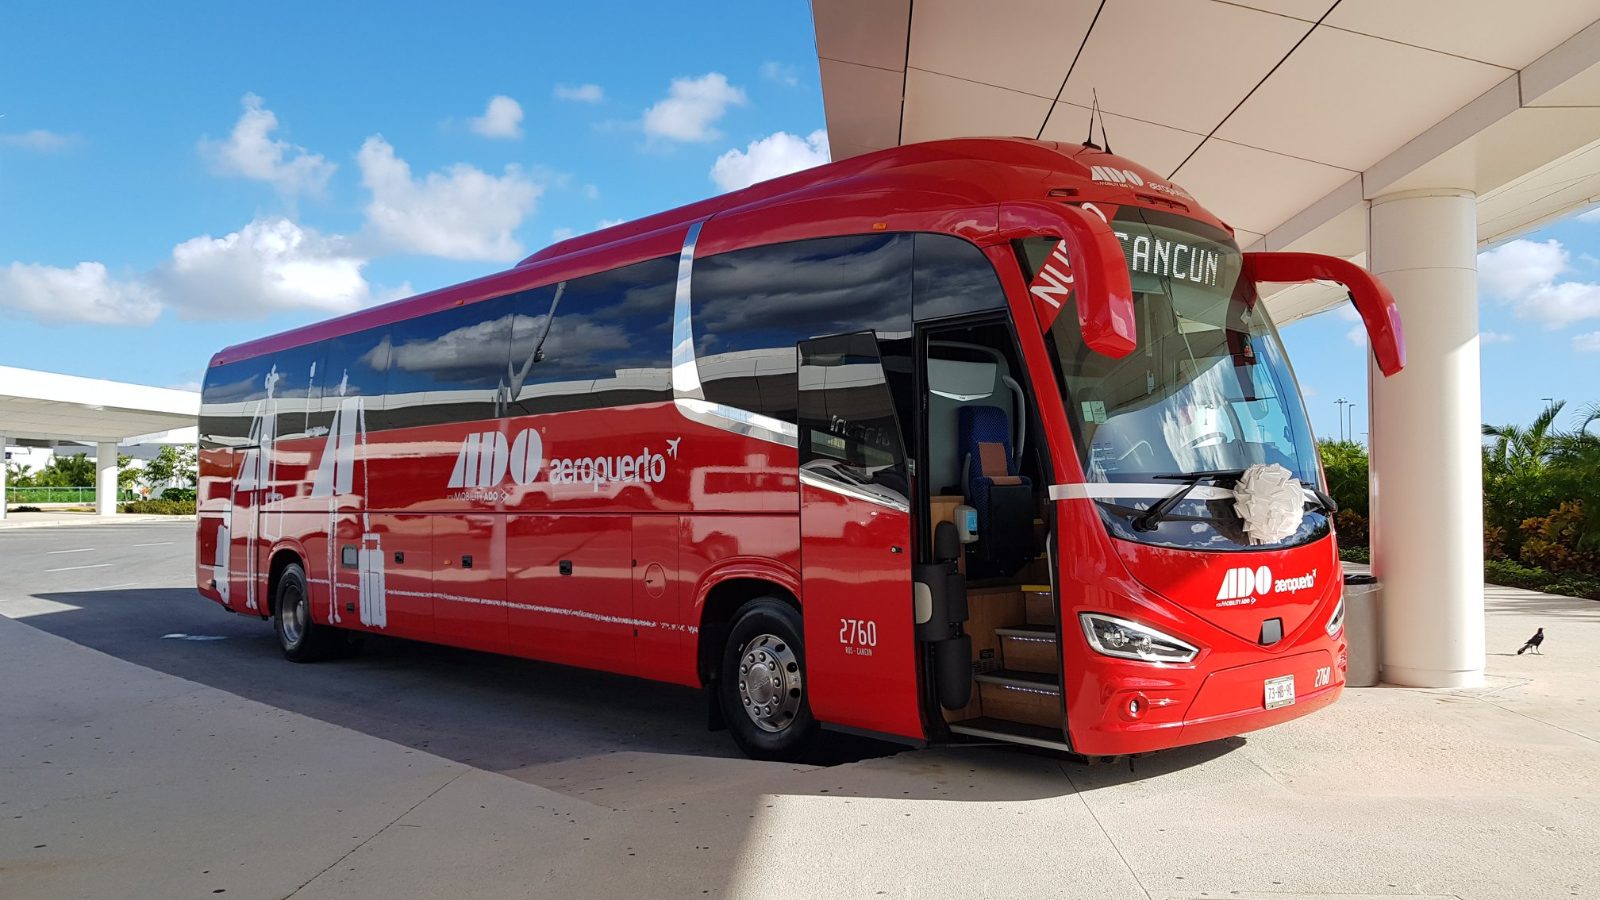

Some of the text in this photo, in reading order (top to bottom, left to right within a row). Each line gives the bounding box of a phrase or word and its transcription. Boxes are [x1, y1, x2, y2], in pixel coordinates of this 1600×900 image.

[1090, 166, 1144, 187] ADO
[447, 428, 666, 492] ADO aeropuerto
[1216, 565, 1314, 600] ADO aeropuerto
[840, 618, 877, 647] 2760
[1314, 666, 1331, 688] 2760
